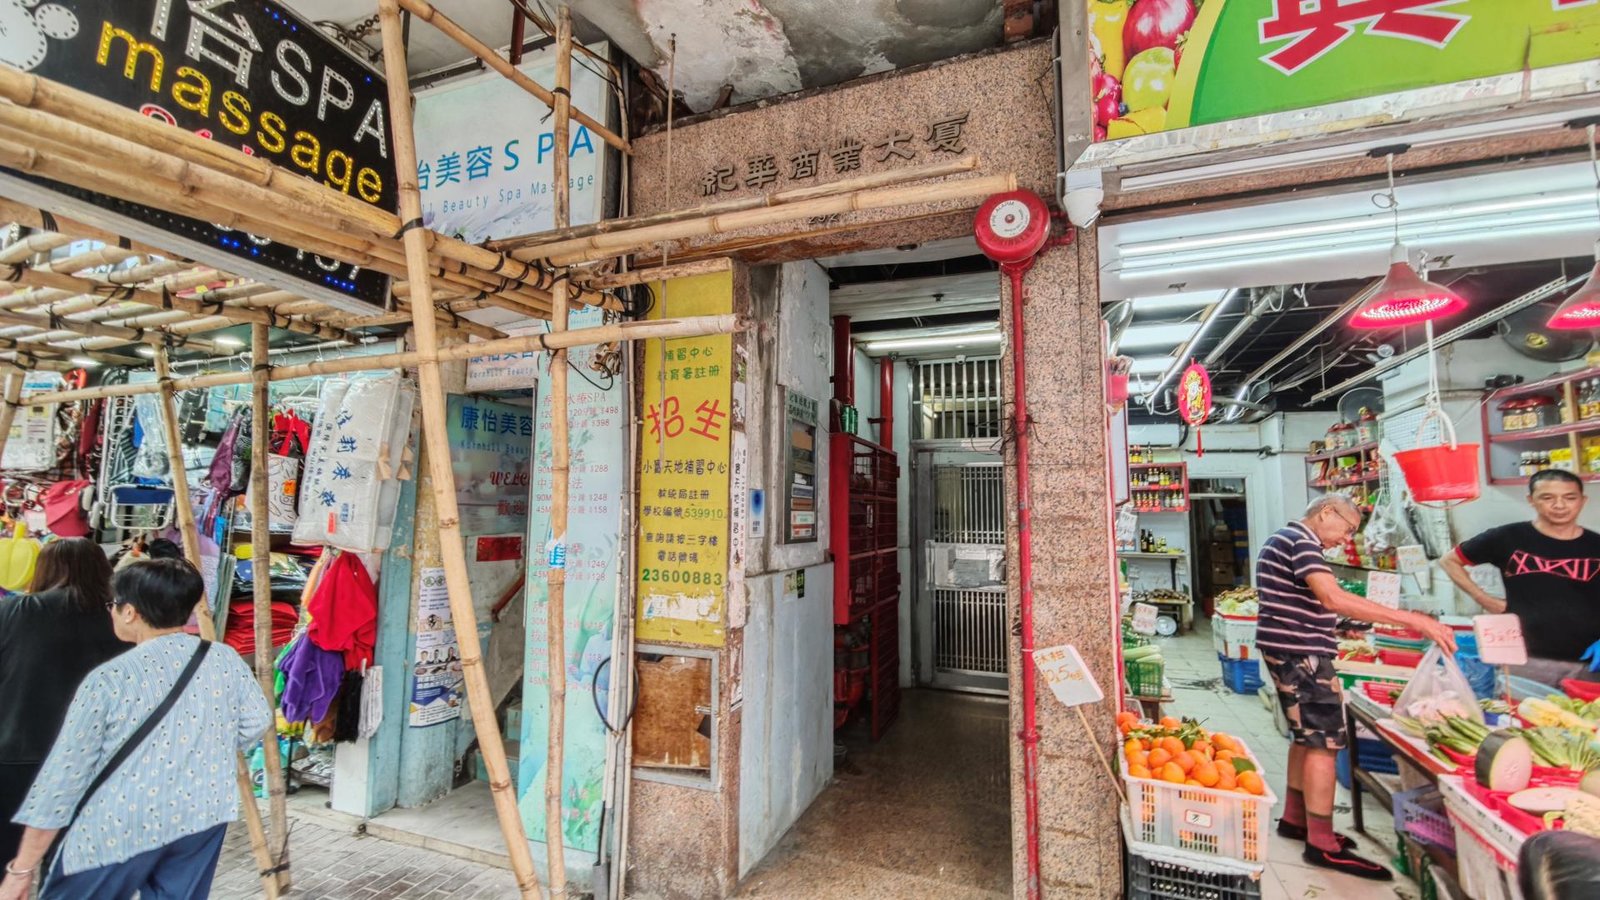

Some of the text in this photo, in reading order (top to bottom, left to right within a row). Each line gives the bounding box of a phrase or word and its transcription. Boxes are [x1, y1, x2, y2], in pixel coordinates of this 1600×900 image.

[96, 20, 383, 203] massage
[701, 111, 970, 196] 紀華商業大廈
[443, 173, 594, 214] Beauty Spa Masage
[461, 406, 533, 436] 康怡美容
[646, 396, 727, 444] 招生
[642, 568, 723, 586] 23600883
